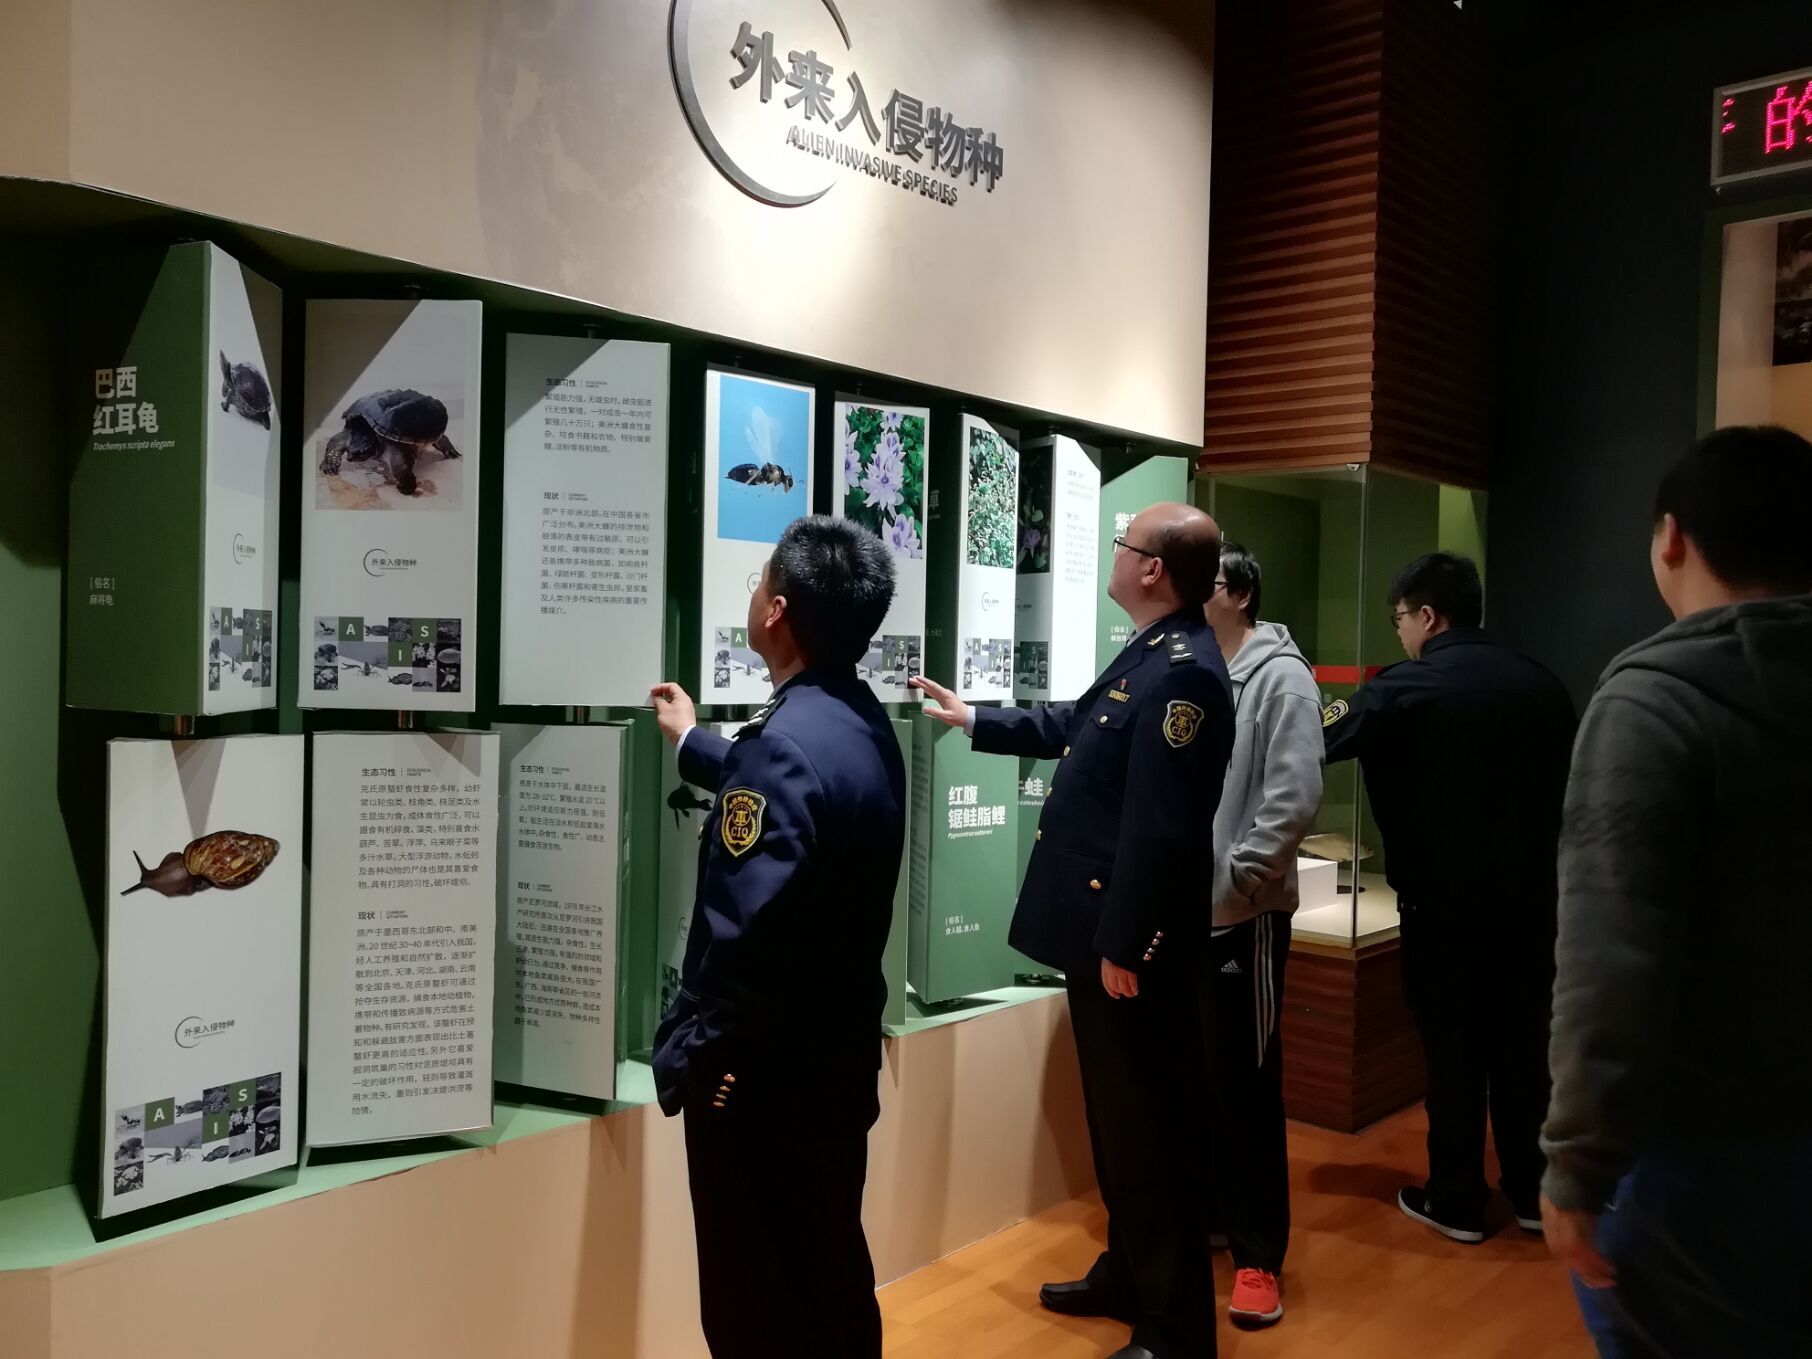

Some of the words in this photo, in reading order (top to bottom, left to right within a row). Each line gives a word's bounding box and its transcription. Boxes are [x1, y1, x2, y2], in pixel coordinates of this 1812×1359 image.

[729, 21, 1003, 193] 外来入侵物种
[786, 125, 836, 158] ALIEN
[835, 143, 901, 187] INVASIVE
[902, 171, 958, 206] SPECIES
[95, 366, 137, 399] 巴西
[92, 401, 159, 435] 红耳龟
[346, 624, 356, 634] A
[420, 625, 429, 638] S
[735, 632, 742, 642] A
[900, 640, 904, 649] S
[362, 768, 396, 777] 生态习性
[948, 785, 978, 806] 红腹
[1018, 778, 1044, 796] 蛙
[948, 806, 1006, 829] 锯鲑脂鲤
[731, 826, 748, 838] CIQ
[358, 911, 376, 920] 现状
[184, 1019, 236, 1037] 外来入侵物种
[153, 1108, 165, 1122] A
[238, 1088, 248, 1101] S
